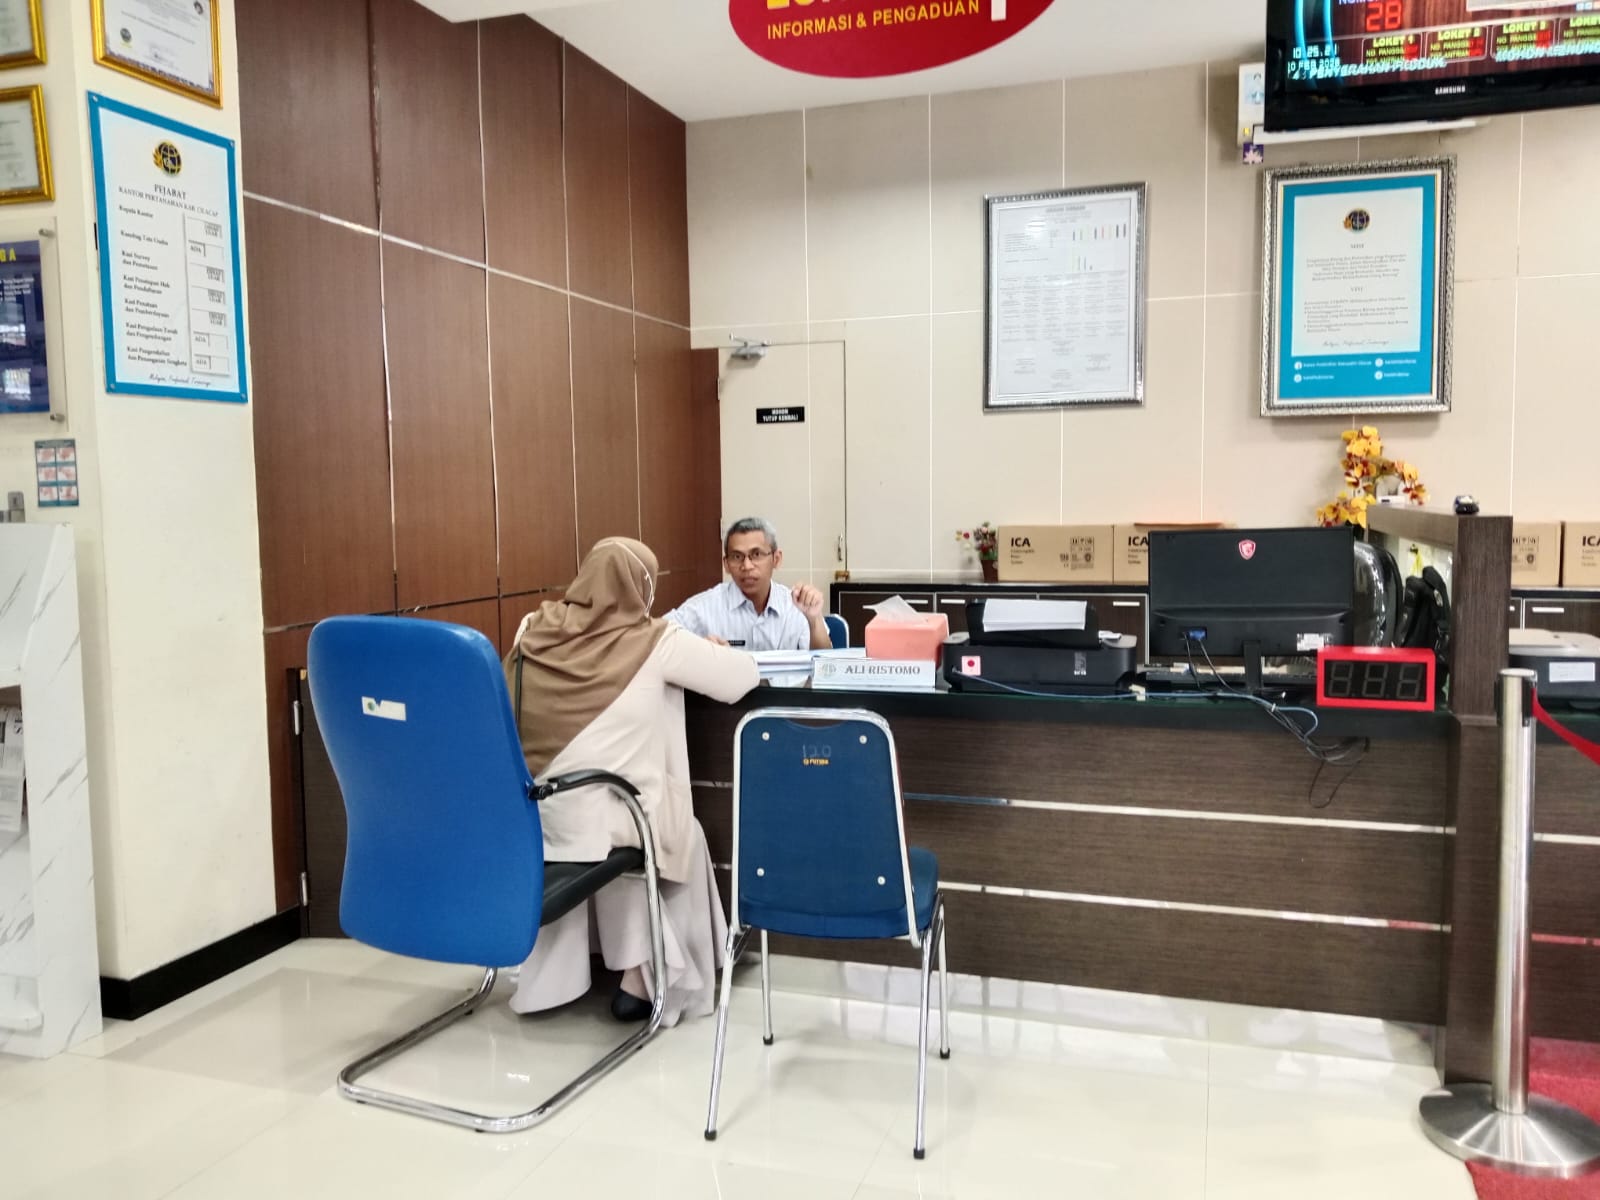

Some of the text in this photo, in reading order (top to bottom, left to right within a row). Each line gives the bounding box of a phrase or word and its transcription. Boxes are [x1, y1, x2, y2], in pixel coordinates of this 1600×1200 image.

[767, 14, 852, 40] INFORMASI
[856, 13, 867, 28] &
[873, 0, 980, 28] PENGADUAN
[1366, 0, 1402, 32] 28
[1503, 22, 1536, 34] LOKET
[1438, 28, 1471, 41] LOKET
[1372, 35, 1405, 48] LOKET
[1435, 85, 1466, 96] SAMSUNG
[119, 185, 144, 199] KANTOR
[154, 183, 186, 201] PEJABAT
[778, 414, 799, 422] KEMBALI
[1010, 537, 1031, 548] ICA
[1128, 536, 1149, 547] ICA
[845, 664, 921, 676] ALI RISTOMO
